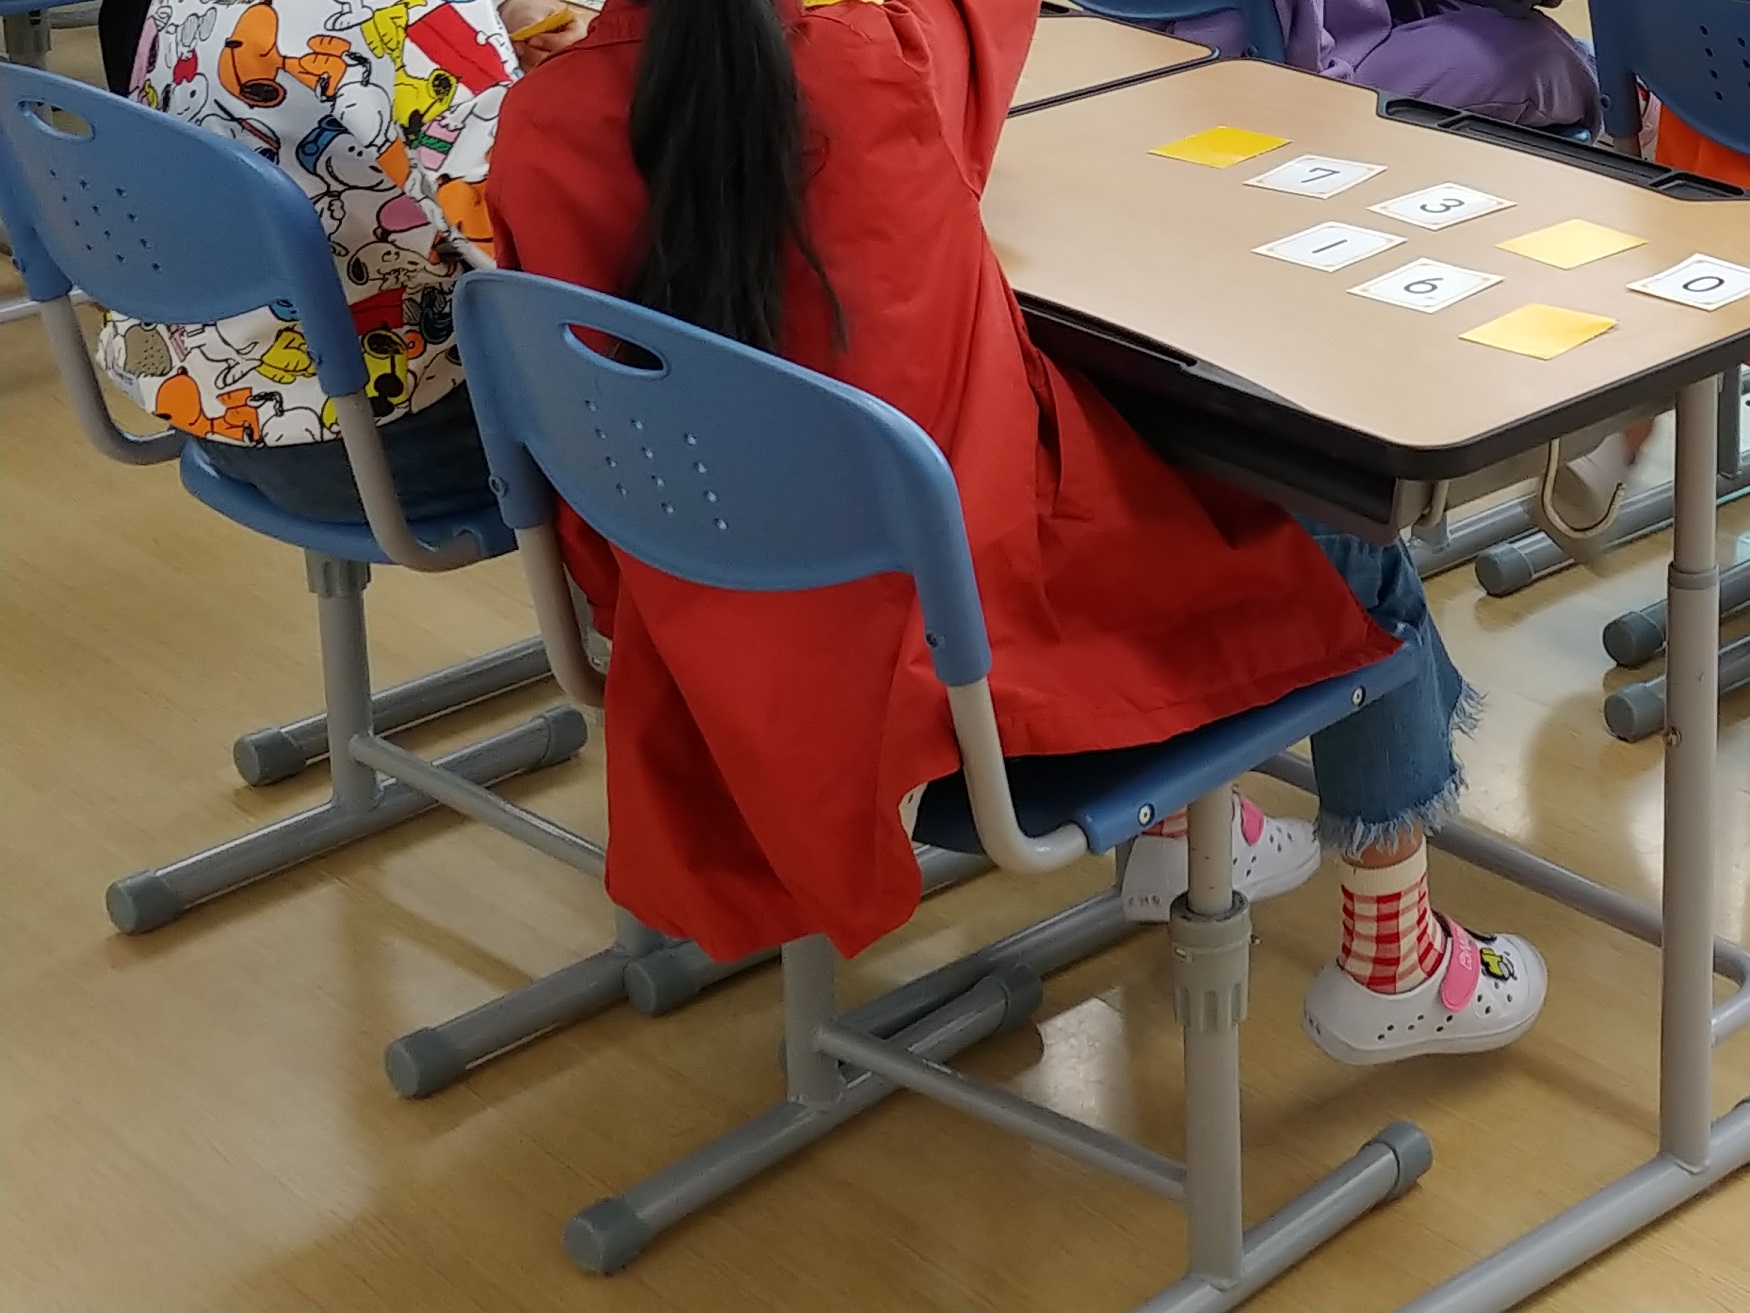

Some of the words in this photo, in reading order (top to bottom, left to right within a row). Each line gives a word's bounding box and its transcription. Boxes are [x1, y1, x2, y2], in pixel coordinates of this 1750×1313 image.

[1300, 166, 1341, 184] 7
[1419, 197, 1465, 214] 3
[1311, 238, 1348, 255] 1
[1403, 277, 1444, 295] 6
[1682, 275, 1726, 293] 0
